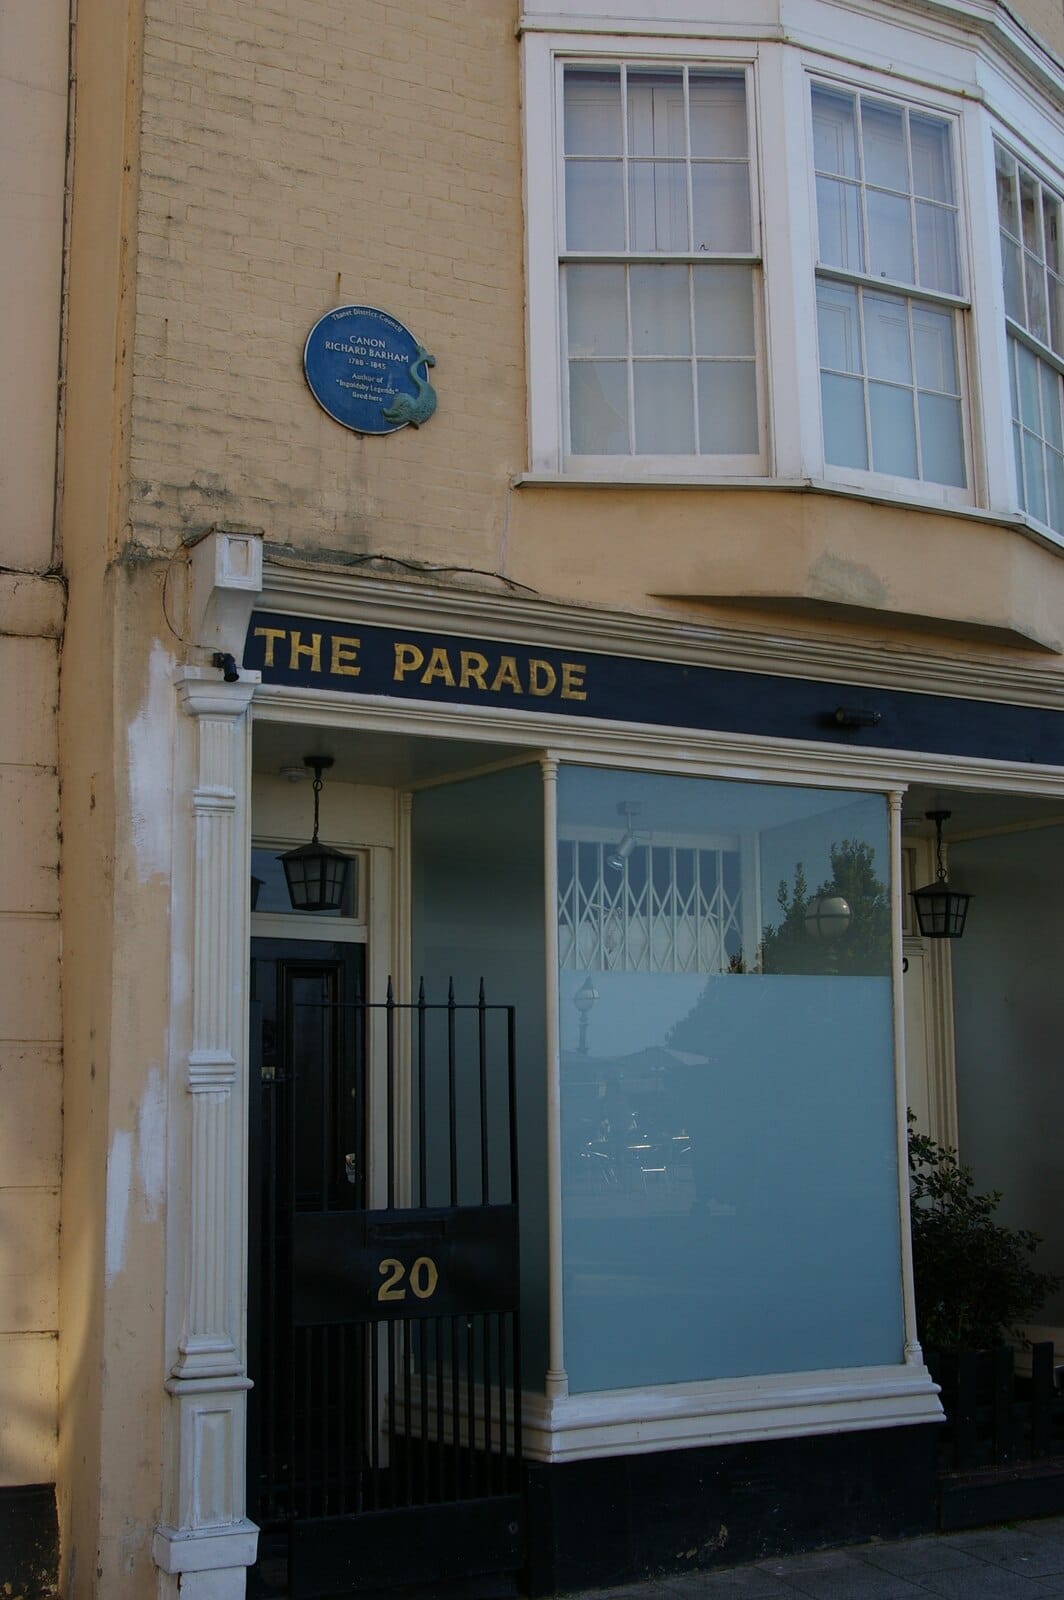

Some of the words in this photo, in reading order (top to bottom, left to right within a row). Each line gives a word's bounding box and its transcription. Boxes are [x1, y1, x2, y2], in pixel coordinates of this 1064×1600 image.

[353, 308, 378, 319] District
[379, 314, 403, 333] Council
[325, 341, 367, 356] RICHARD
[369, 349, 409, 363] BARHAM
[349, 335, 386, 349] CANON
[370, 361, 386, 370] 1845
[377, 376, 384, 384] of
[254, 627, 361, 677] THE
[393, 642, 588, 701] PARADE
[377, 1256, 439, 1302] 20
